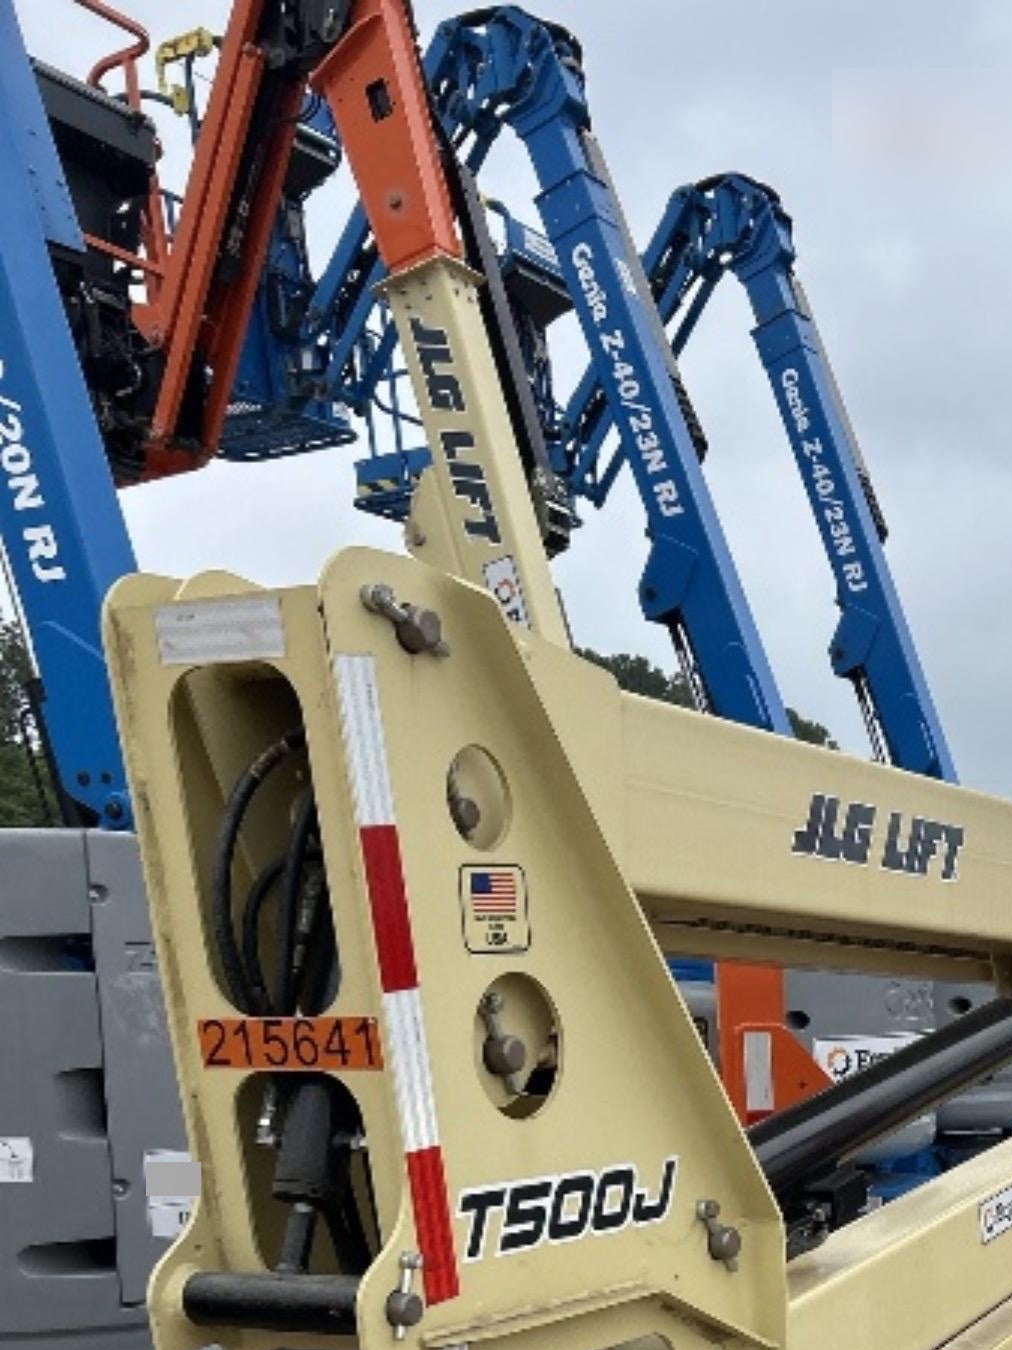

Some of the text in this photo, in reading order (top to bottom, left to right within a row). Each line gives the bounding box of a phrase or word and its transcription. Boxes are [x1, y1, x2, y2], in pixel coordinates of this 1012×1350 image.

[409, 316, 501, 546] JLG LIFT
[572, 242, 608, 326] Genie
[600, 329, 668, 474] Z-40/23N
[653, 479, 685, 518] RJ
[781, 368, 868, 592] Genie Z-40/23N RJ
[23, 524, 66, 583] RJ
[792, 792, 964, 884] JLG LIFT
[202, 1017, 376, 1067] 215641
[456, 1155, 680, 1263] T500J
